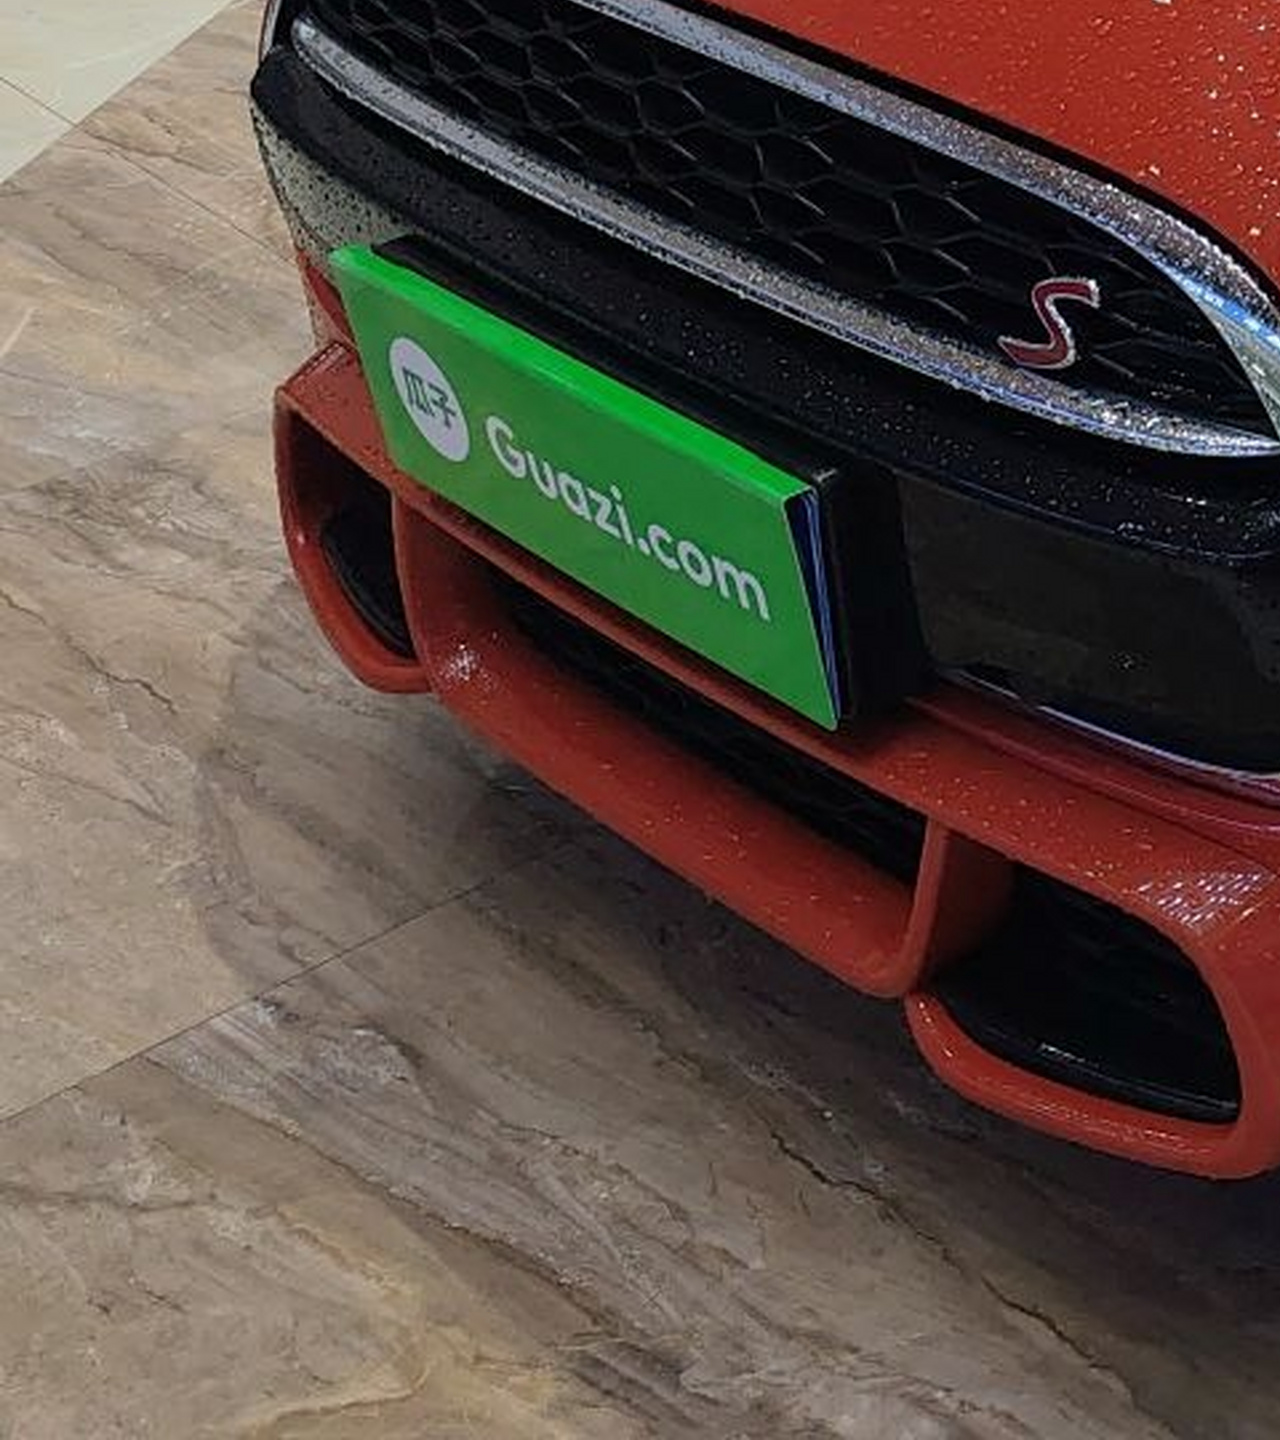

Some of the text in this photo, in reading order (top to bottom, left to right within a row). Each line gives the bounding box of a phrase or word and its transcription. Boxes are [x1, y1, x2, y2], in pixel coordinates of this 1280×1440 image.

[997, 277, 1101, 369] S
[401, 365, 456, 430] 瓜子
[485, 415, 771, 622] Guazi.com
